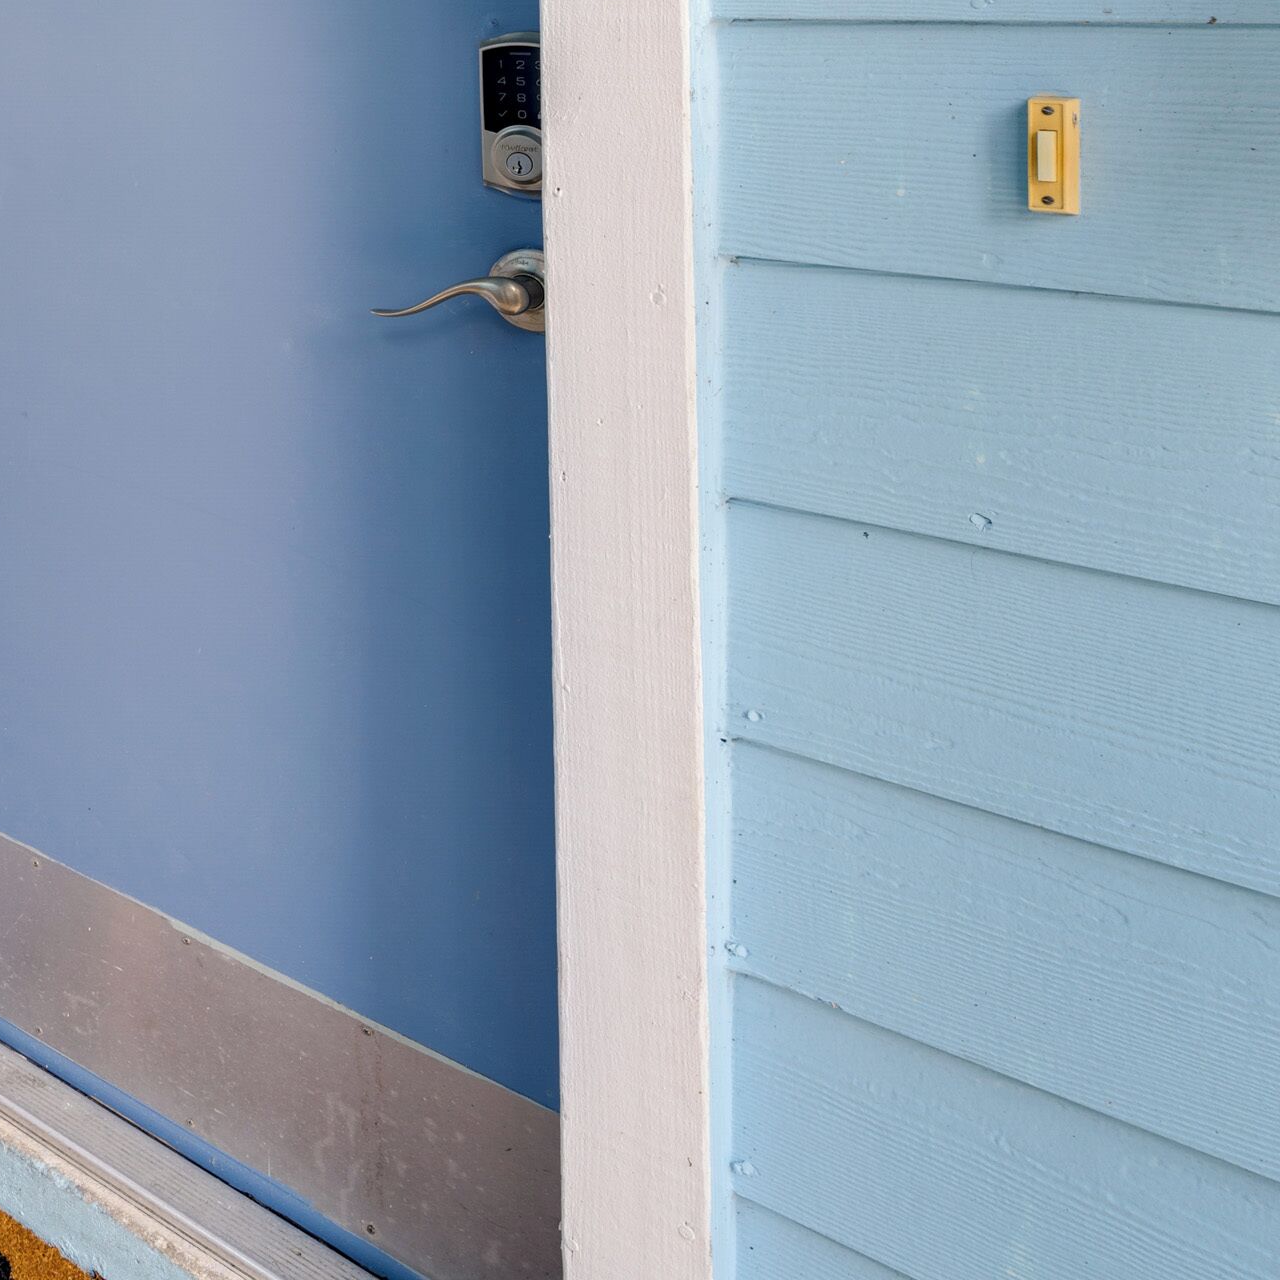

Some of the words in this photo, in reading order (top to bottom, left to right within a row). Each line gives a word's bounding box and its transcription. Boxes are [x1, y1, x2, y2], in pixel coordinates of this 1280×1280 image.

[515, 60, 525, 70] 2
[497, 76, 506, 85] 4
[516, 76, 526, 86] 5
[498, 92, 507, 101] 7
[516, 93, 526, 103] 8
